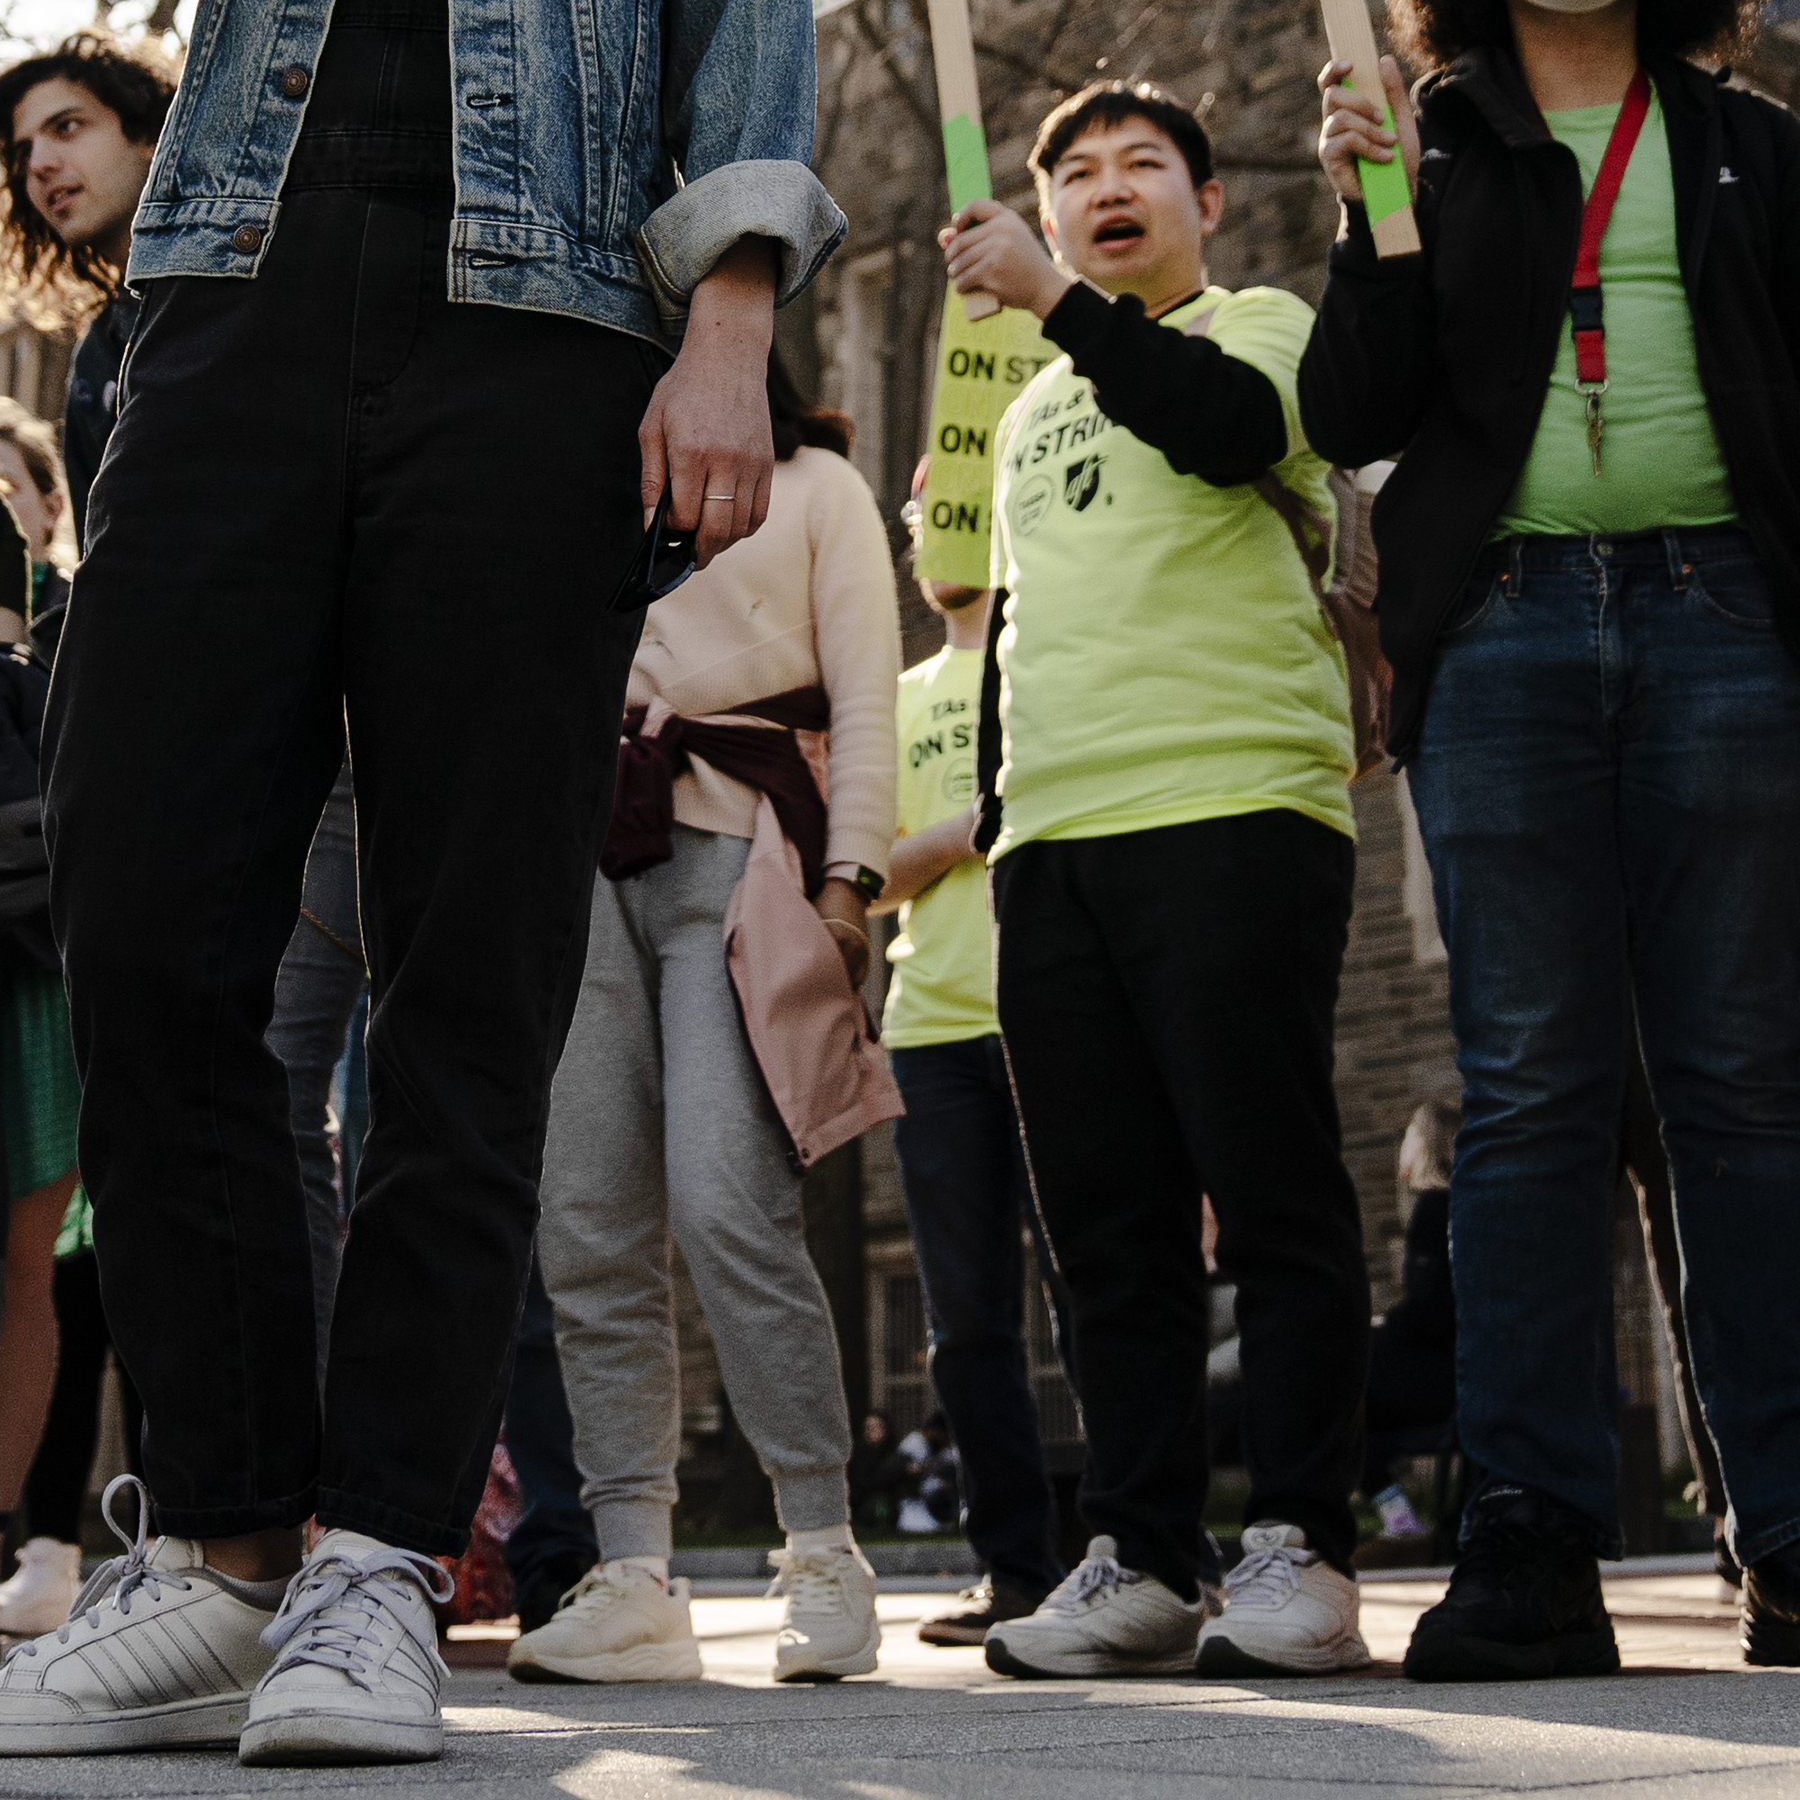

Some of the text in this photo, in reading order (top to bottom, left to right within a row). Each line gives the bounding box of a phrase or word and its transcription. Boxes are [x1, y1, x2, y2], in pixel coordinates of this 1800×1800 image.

[950, 348, 996, 381] ON
[940, 424, 986, 456] ON
[932, 501, 979, 532] ON
